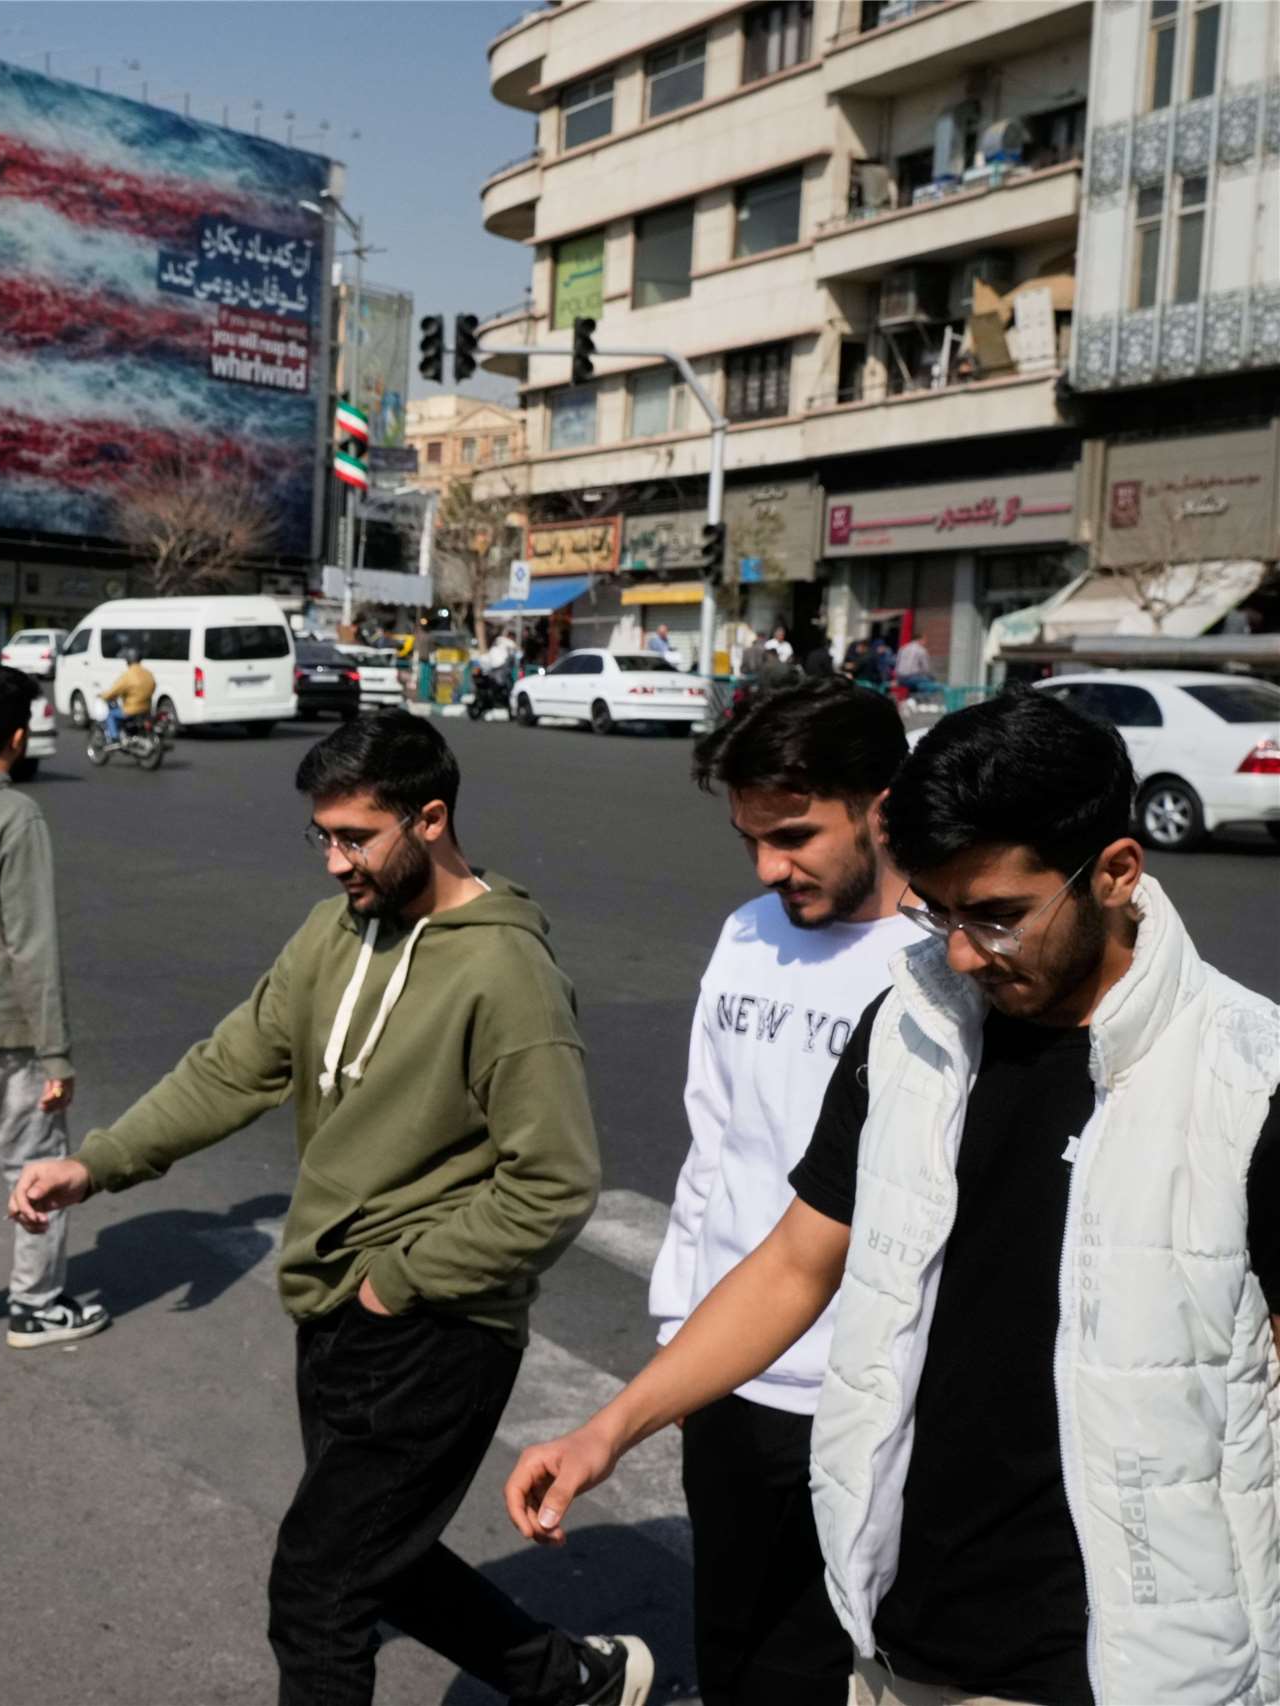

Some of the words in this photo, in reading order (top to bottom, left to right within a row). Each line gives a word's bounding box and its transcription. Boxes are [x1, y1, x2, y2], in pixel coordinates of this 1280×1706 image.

[245, 233, 271, 271] باد
[273, 241, 297, 269] که
[291, 239, 314, 278] آن
[248, 275, 308, 316] طوفان
[212, 328, 238, 347] you
[238, 331, 258, 350] will
[287, 340, 308, 360] the
[211, 349, 307, 390] whirlwind
[717, 993, 794, 1043] NEW
